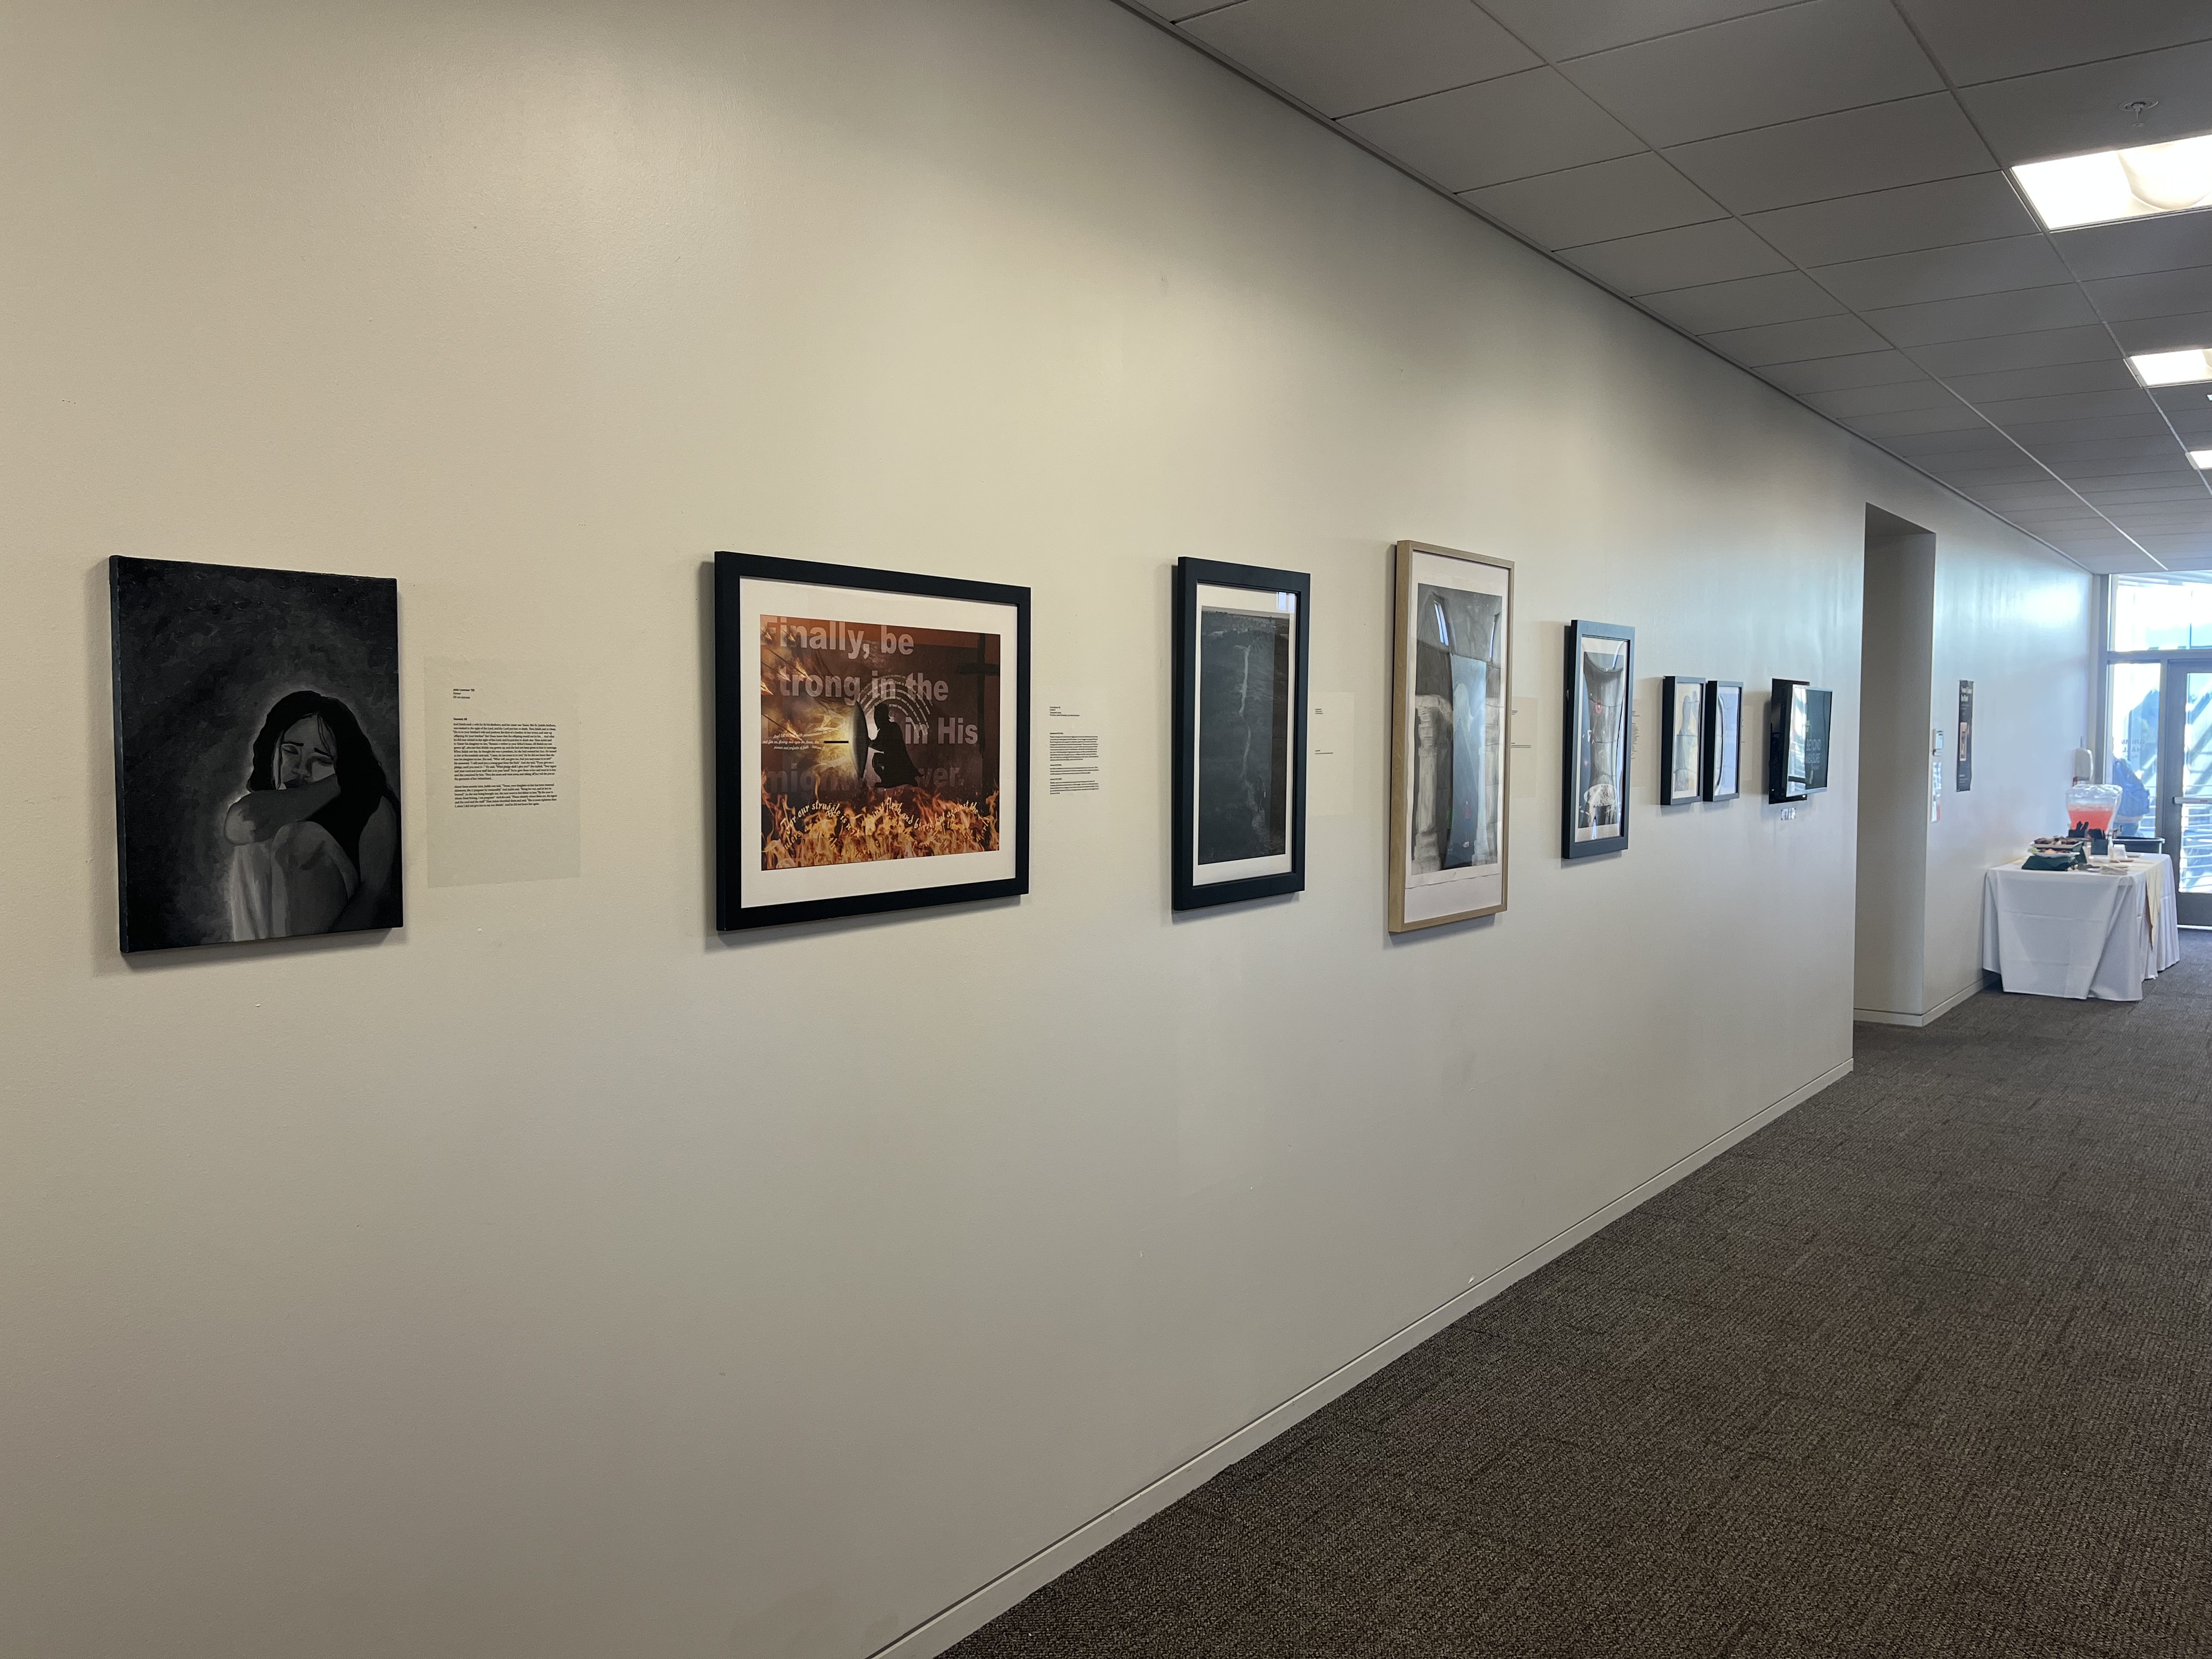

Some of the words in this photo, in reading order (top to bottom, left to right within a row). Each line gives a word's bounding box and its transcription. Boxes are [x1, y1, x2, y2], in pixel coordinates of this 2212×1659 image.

[760, 615, 870, 659] Finally,
[881, 625, 915, 655] be
[779, 666, 860, 706] trong
[871, 670, 896, 699] in
[906, 673, 948, 701] the
[905, 717, 928, 744] in
[938, 717, 978, 744] His
[798, 805, 810, 817] our
[812, 800, 841, 818] struggle
[886, 796, 903, 815] flesh
[901, 812, 915, 825] and
[969, 802, 979, 815] the
